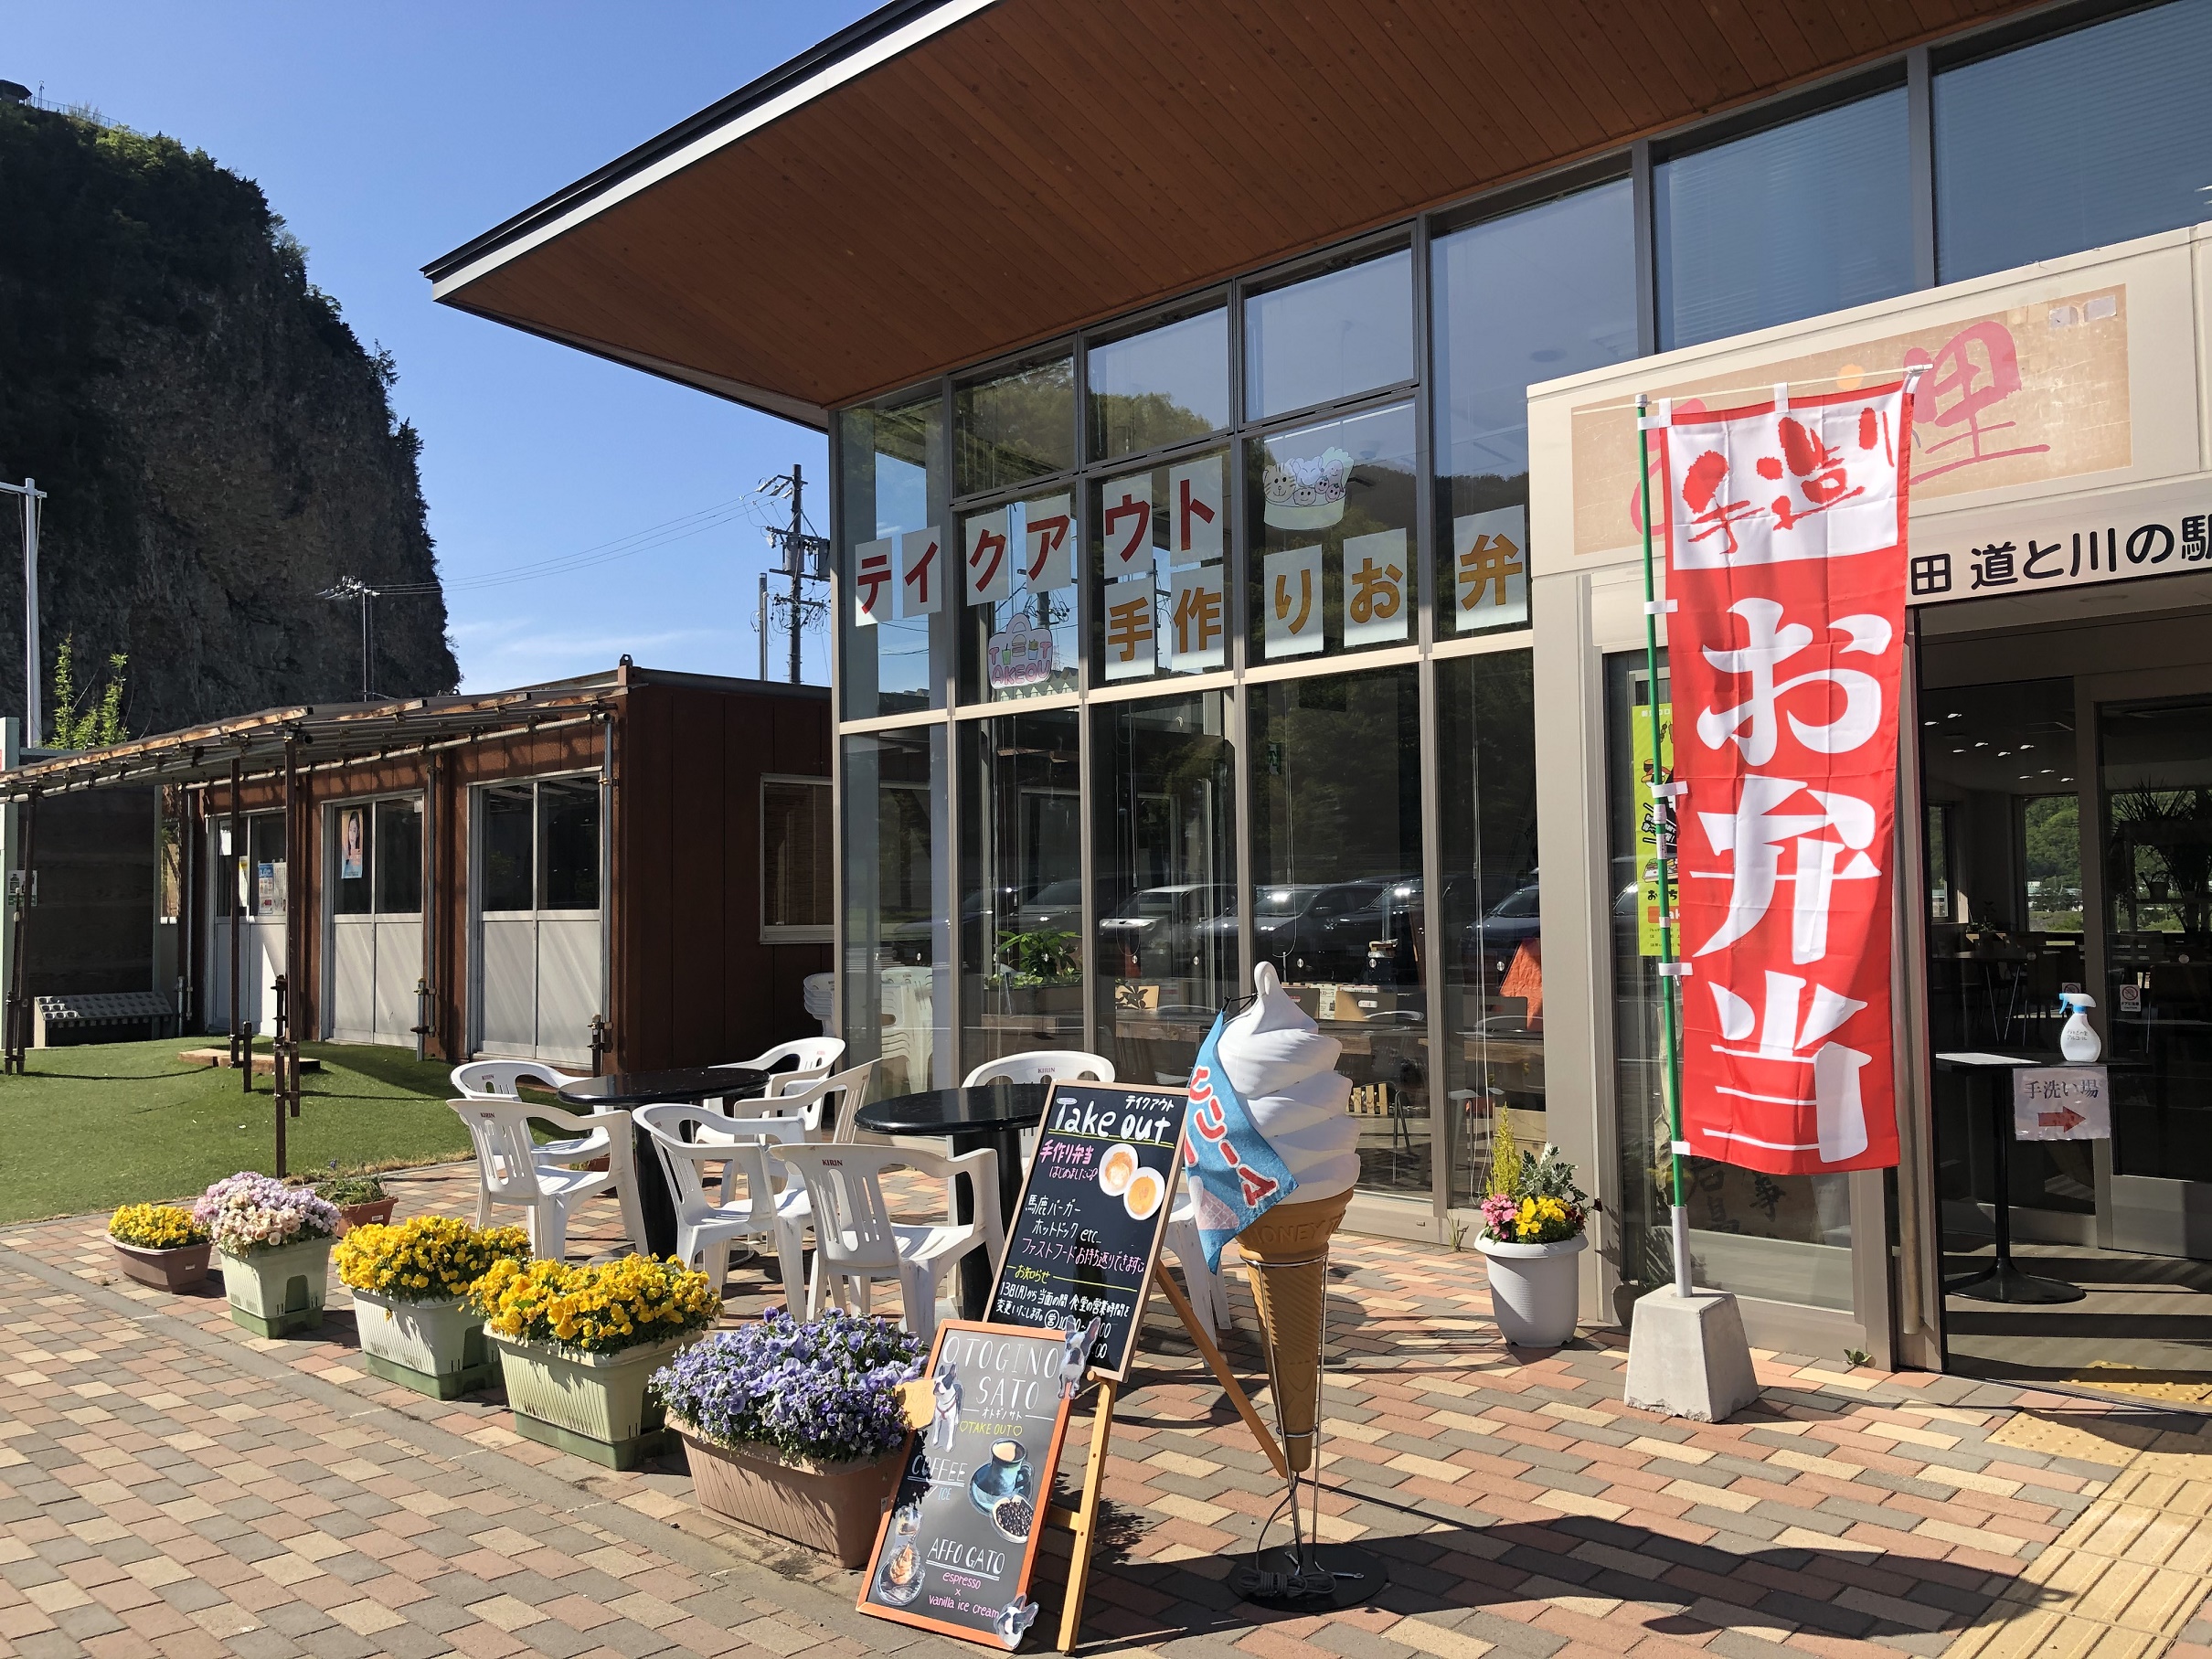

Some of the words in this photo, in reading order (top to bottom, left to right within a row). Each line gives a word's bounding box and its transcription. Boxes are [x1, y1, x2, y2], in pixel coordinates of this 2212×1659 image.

[857, 478, 1216, 615] テイクアウト
[1689, 597, 1893, 1164] お弁当
[2024, 1079, 2100, 1099] 手洗い場
[1125, 1095, 1175, 1111] テイクアウト
[1055, 1097, 1117, 1138] Take
[1121, 1113, 1172, 1144] out
[1039, 1139, 1095, 1164] 手作り弁当
[1025, 1194, 1081, 1218] 馬鹿バーガー
[1015, 1264, 1051, 1284] お知らせ
[941, 1335, 1059, 1378] OTOGINO
[975, 1376, 1040, 1410] SATO
[968, 1421, 992, 1435] TAKE
[994, 1423, 1012, 1436] OUT
[911, 1454, 968, 1482] COFFEE
[938, 1487, 952, 1501] ICE
[942, 1572, 982, 1590] espresso
[929, 1594, 955, 1610] vanilla
[957, 1599, 970, 1611] ice
[973, 1604, 1000, 1619] cream
